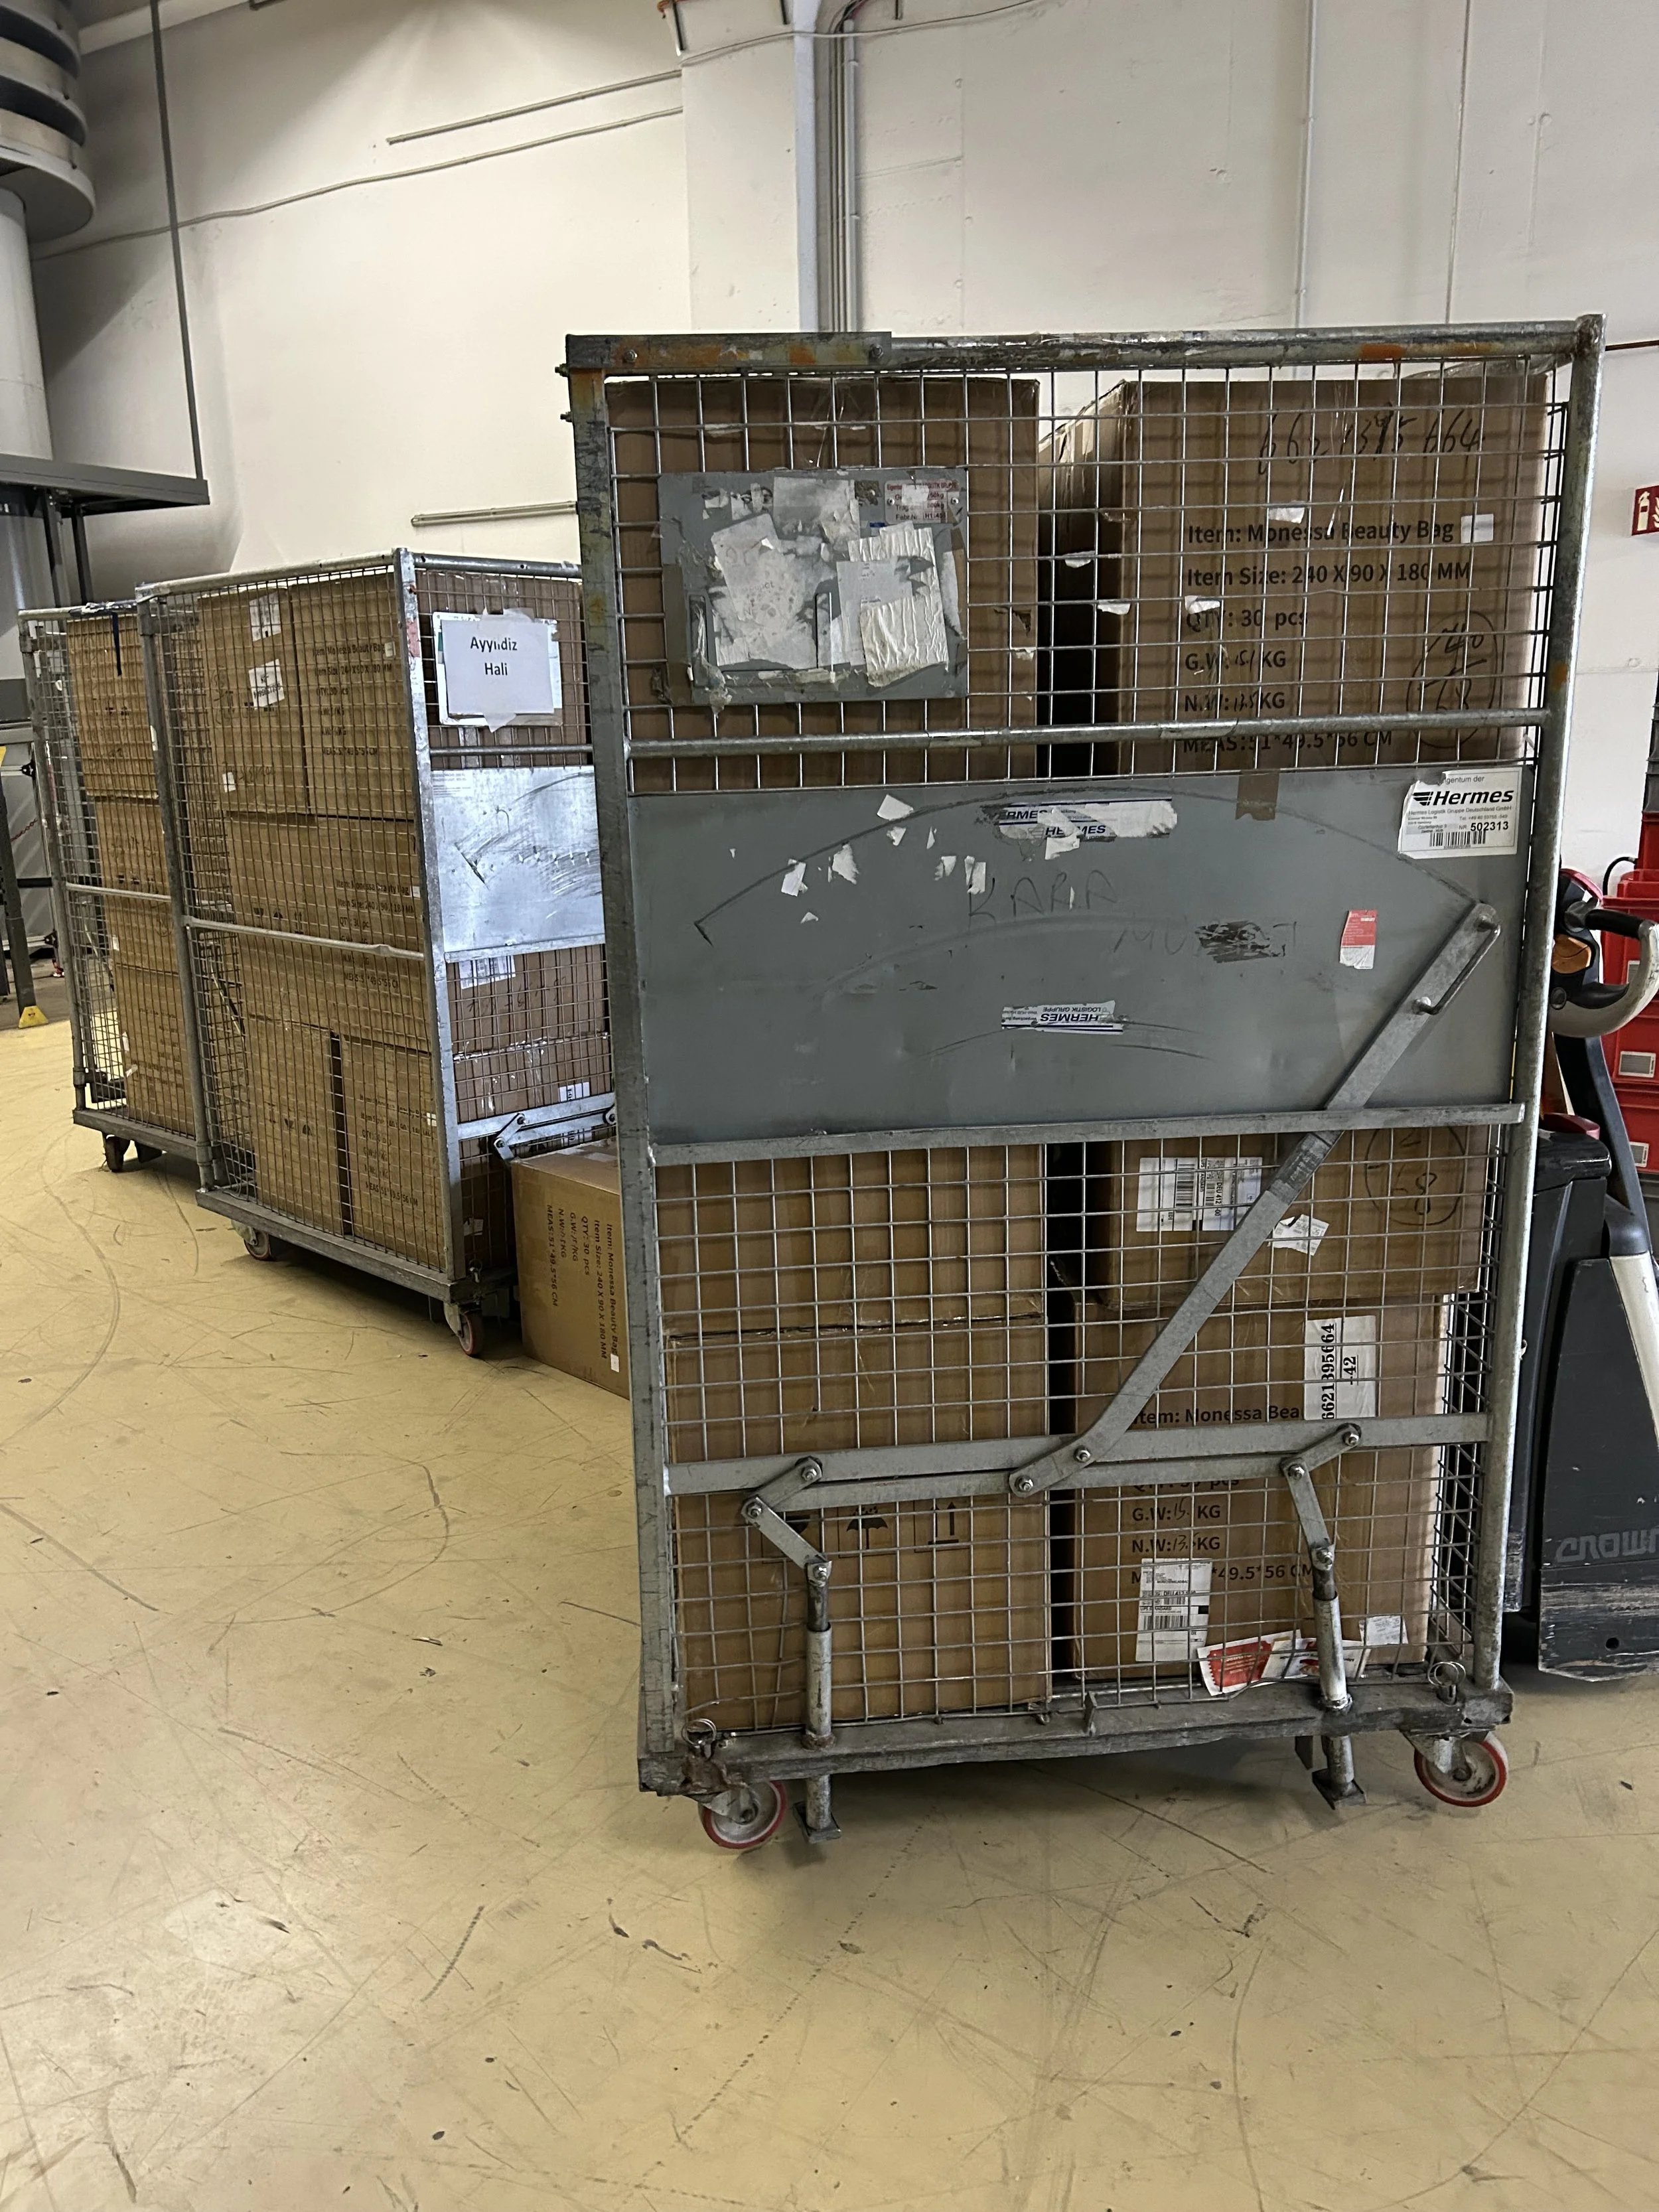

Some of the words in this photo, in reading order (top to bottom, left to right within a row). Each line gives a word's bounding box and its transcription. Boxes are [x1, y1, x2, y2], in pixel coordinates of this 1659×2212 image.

[1189, 525, 1241, 544] Item:
[1342, 522, 1411, 544] Beauty
[1417, 520, 1454, 543] Bag
[1188, 569, 1232, 587] Item
[1292, 565, 1327, 584] 240
[1350, 564, 1374, 582] 90
[1437, 562, 1471, 580] MM
[1275, 611, 1308, 630] pcs
[484, 662, 508, 676] Hali
[1433, 790, 1514, 806] Hermes
[1470, 821, 1509, 832] 502313
[583, 1242, 589, 1254] 30
[551, 1292, 558, 1307] CM
[600, 1341, 607, 1359] MM
[1134, 1410, 1179, 1424] tem:
[1269, 1405, 1300, 1420] Bea
[1132, 1507, 1171, 1522] G.W:
[1197, 1505, 1221, 1519] KG
[1131, 1539, 1171, 1553] N.W:
[1197, 1536, 1220, 1550] KG
